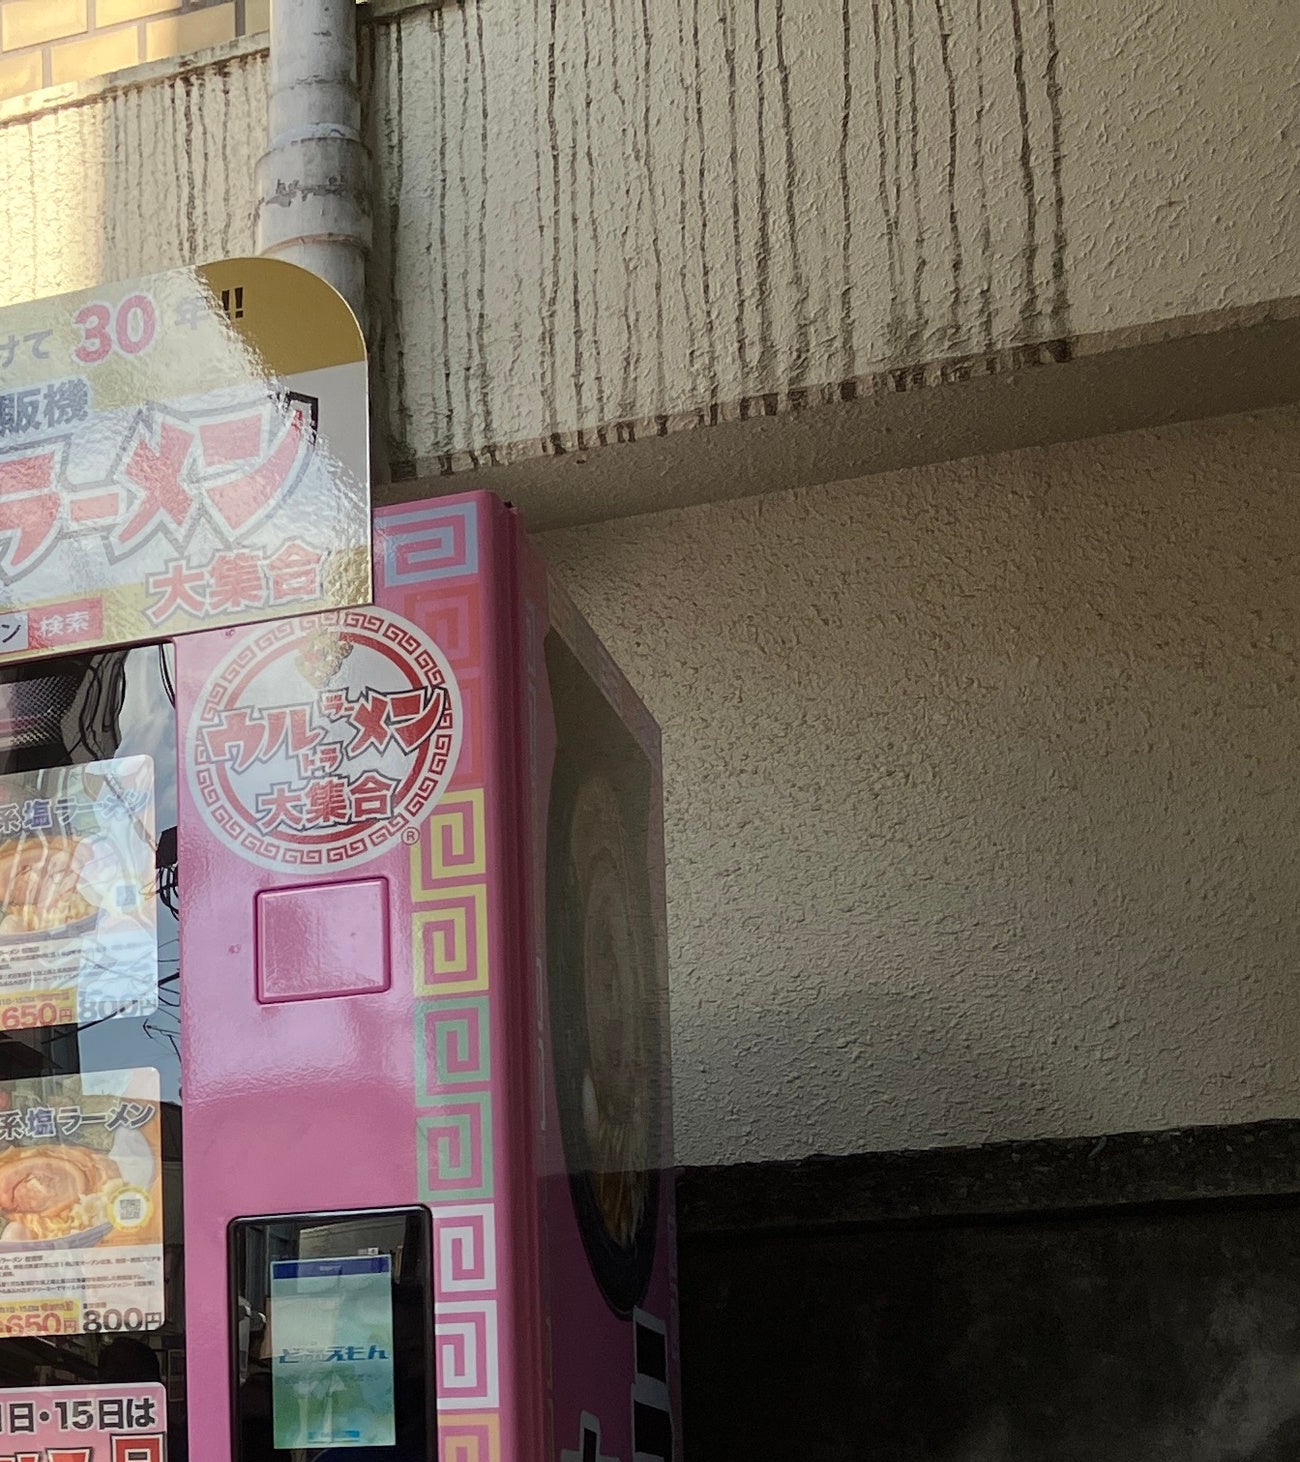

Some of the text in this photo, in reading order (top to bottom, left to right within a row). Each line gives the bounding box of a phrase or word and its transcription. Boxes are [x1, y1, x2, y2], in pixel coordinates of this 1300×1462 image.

[142, 545, 325, 625] 大集合
[257, 770, 400, 834] 大集合
[82, 1307, 162, 1334] 800円
